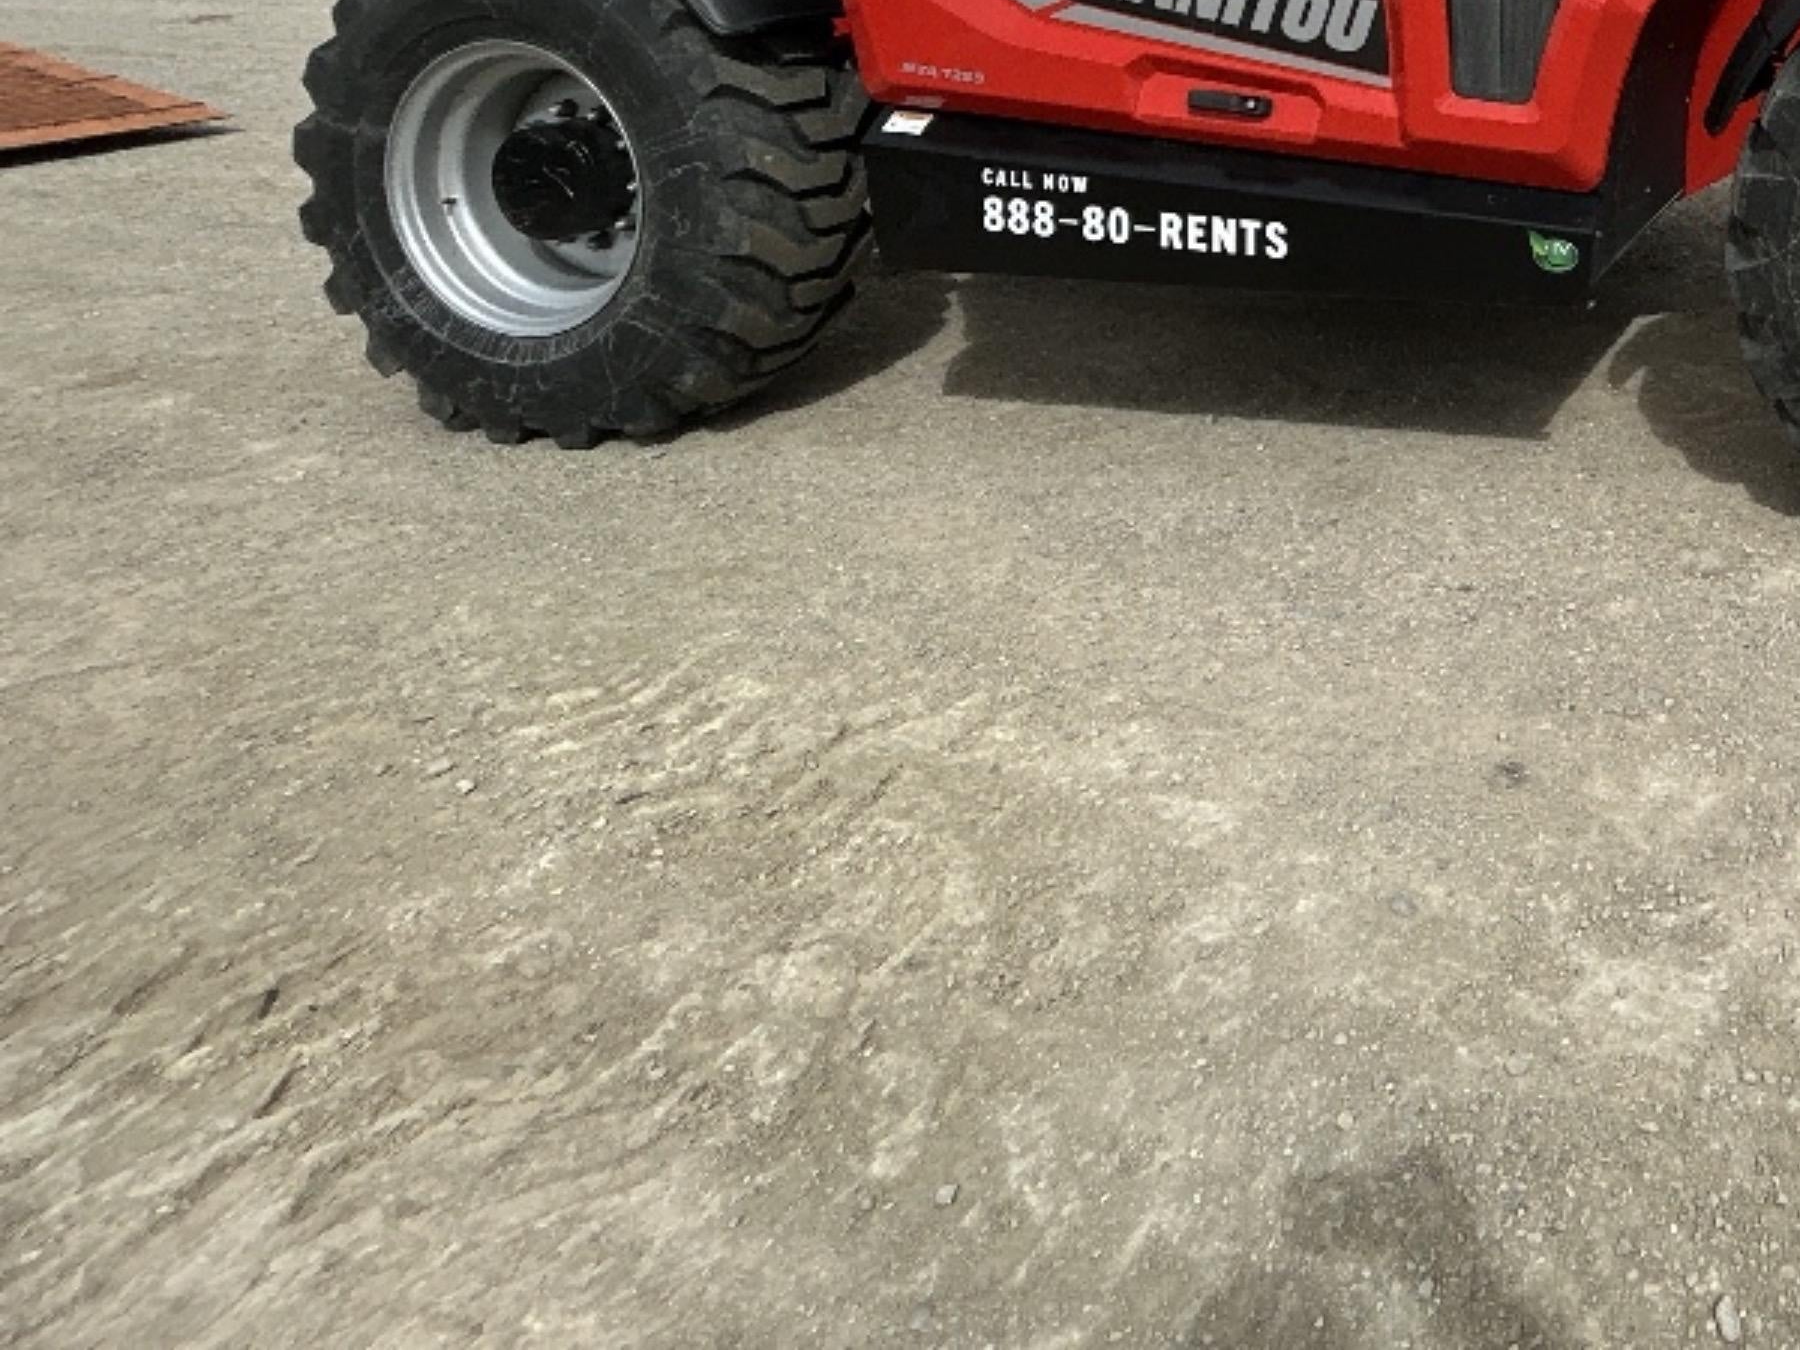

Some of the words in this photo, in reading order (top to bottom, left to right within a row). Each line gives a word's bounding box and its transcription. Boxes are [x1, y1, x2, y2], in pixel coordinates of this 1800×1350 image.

[980, 166, 1033, 190] CALL
[1042, 172, 1089, 194] NOW
[982, 194, 1289, 259] 888-80-RENTS
